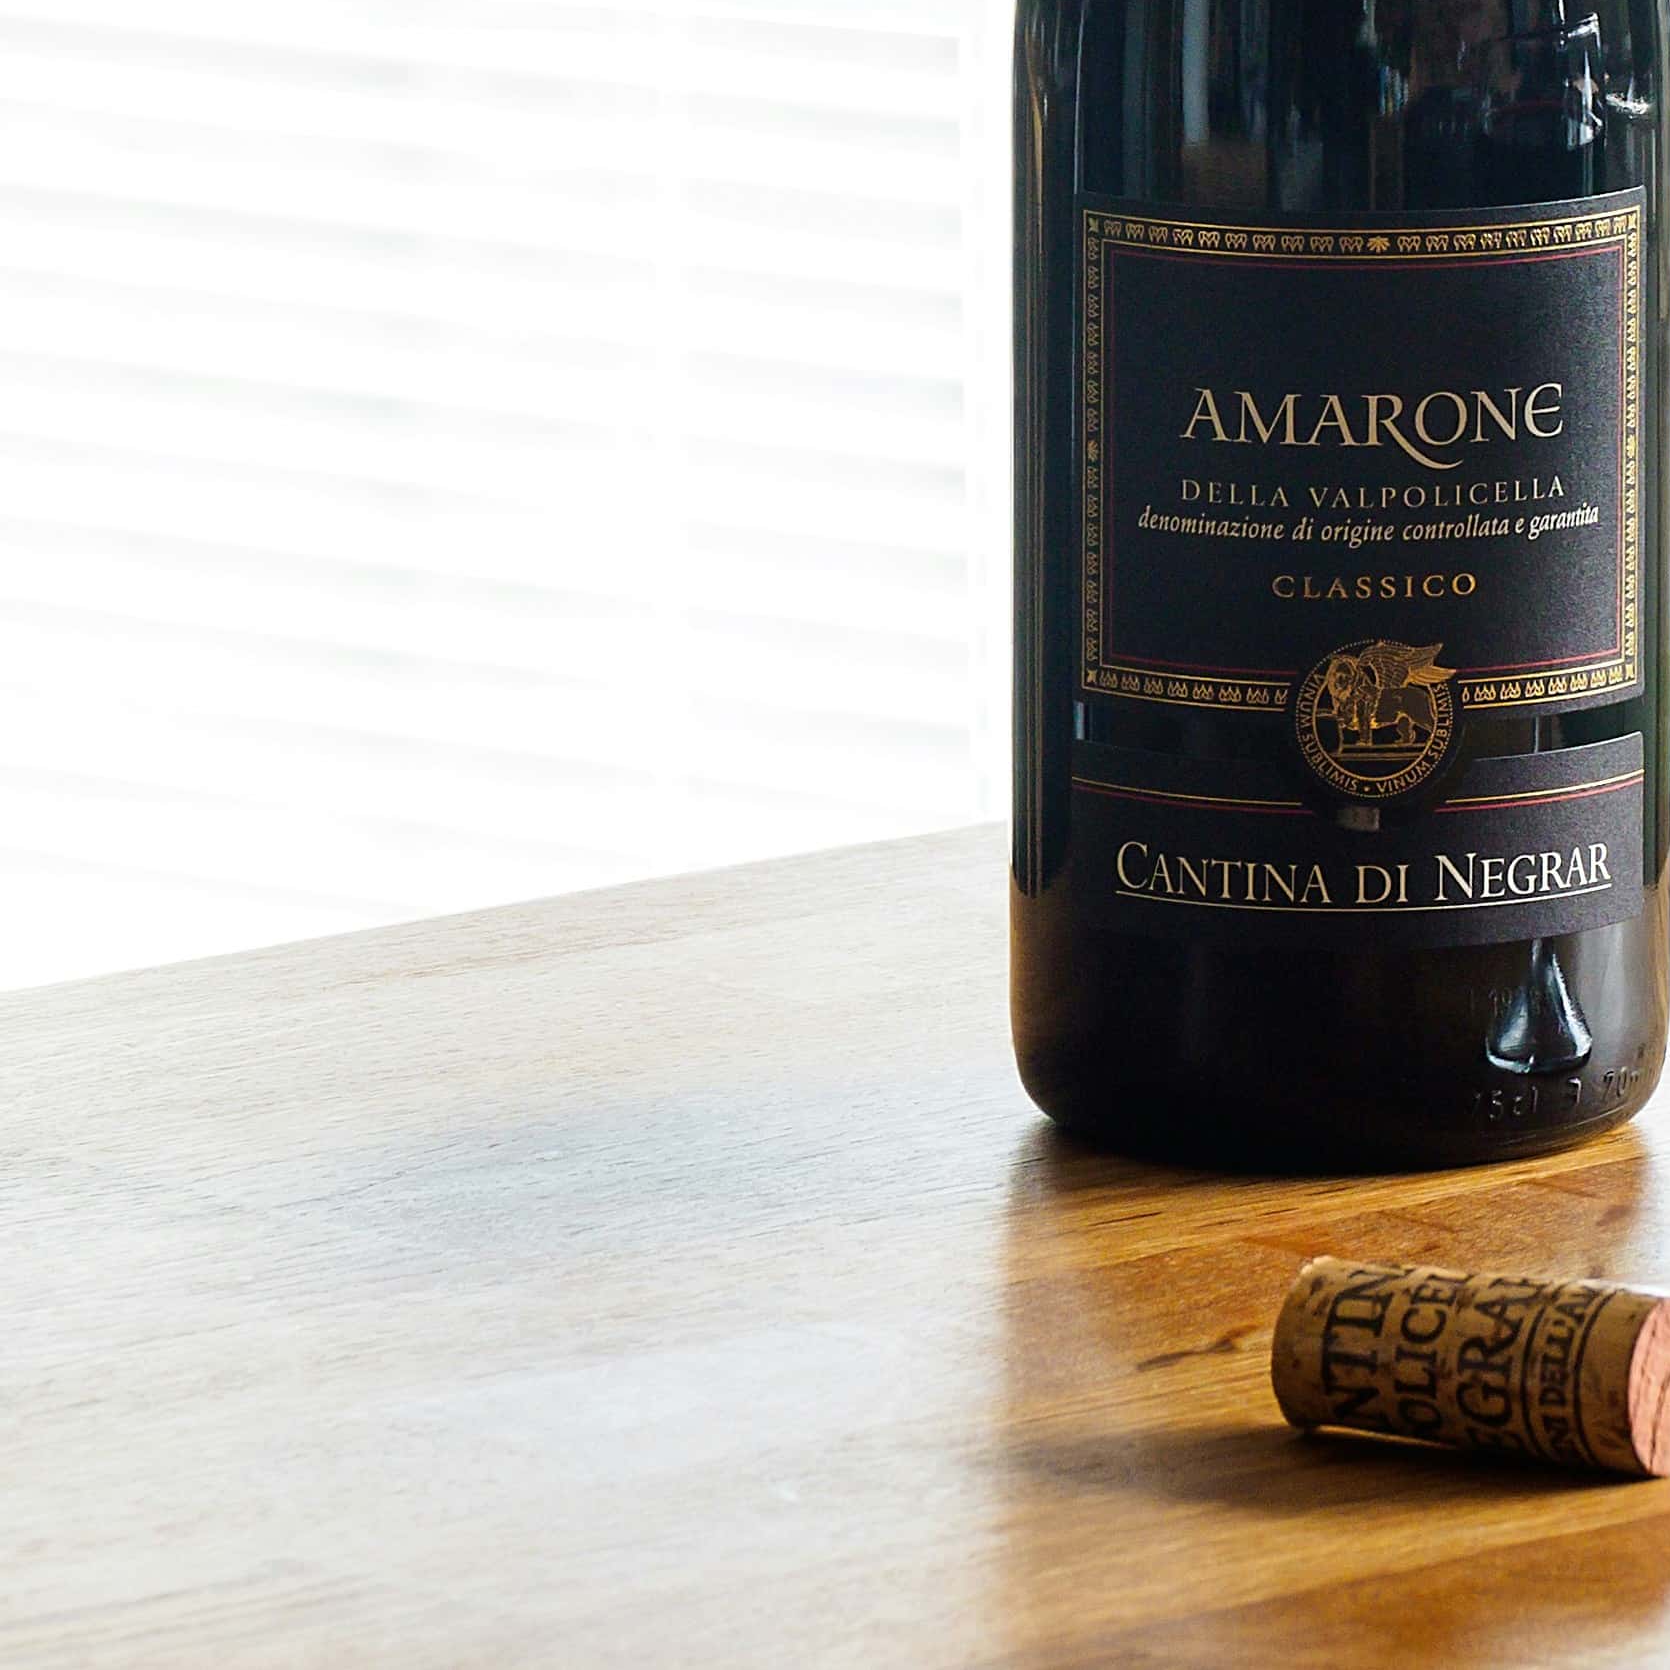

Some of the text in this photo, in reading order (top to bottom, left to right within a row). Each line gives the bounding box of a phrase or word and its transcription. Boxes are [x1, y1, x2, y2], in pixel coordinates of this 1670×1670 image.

[1180, 382, 1563, 470] AMARONE
[1181, 475, 1565, 509] DELLA VALPOLICELLA
[1137, 501, 1599, 550] denominazione di origine controllata e garantita
[1272, 572, 1477, 602] CLASSICO
[1300, 672, 1451, 794] VINUM SUBLIMIS VINUM SUBLIMIS
[1116, 840, 1611, 905] CANTINA DI NEGRAR
